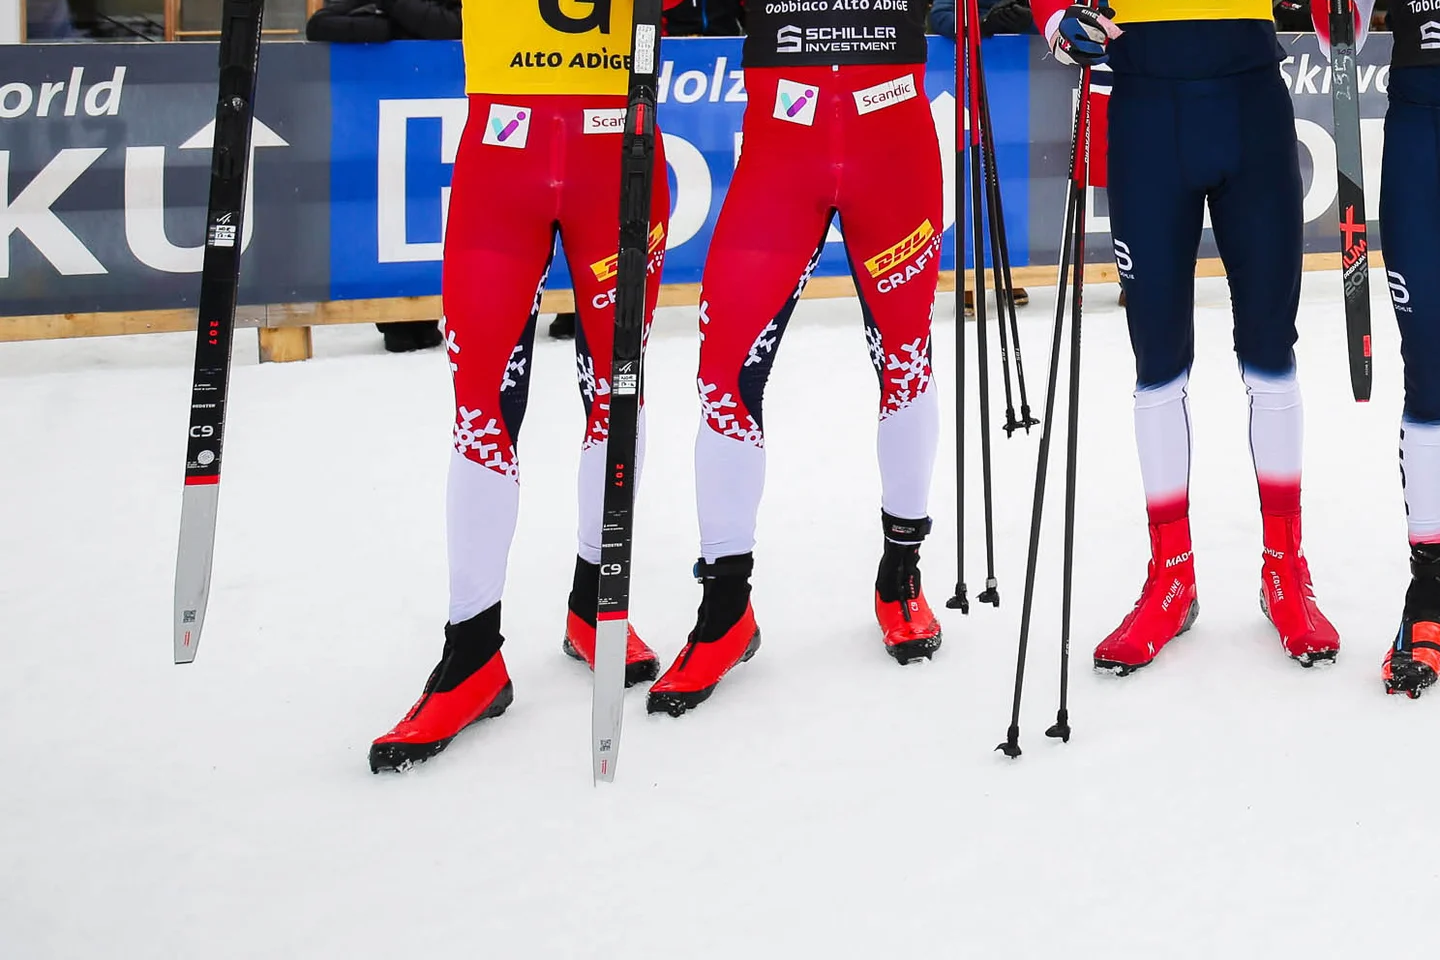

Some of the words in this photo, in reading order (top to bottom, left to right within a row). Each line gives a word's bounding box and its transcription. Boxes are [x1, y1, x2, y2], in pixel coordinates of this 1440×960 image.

[806, 26, 897, 41] SCHILLER
[806, 41, 897, 53] INVESTMENT
[862, 83, 912, 107] Scandic
[877, 244, 937, 294] CRAFT
[190, 424, 214, 438] C9
[600, 563, 622, 576] C9
